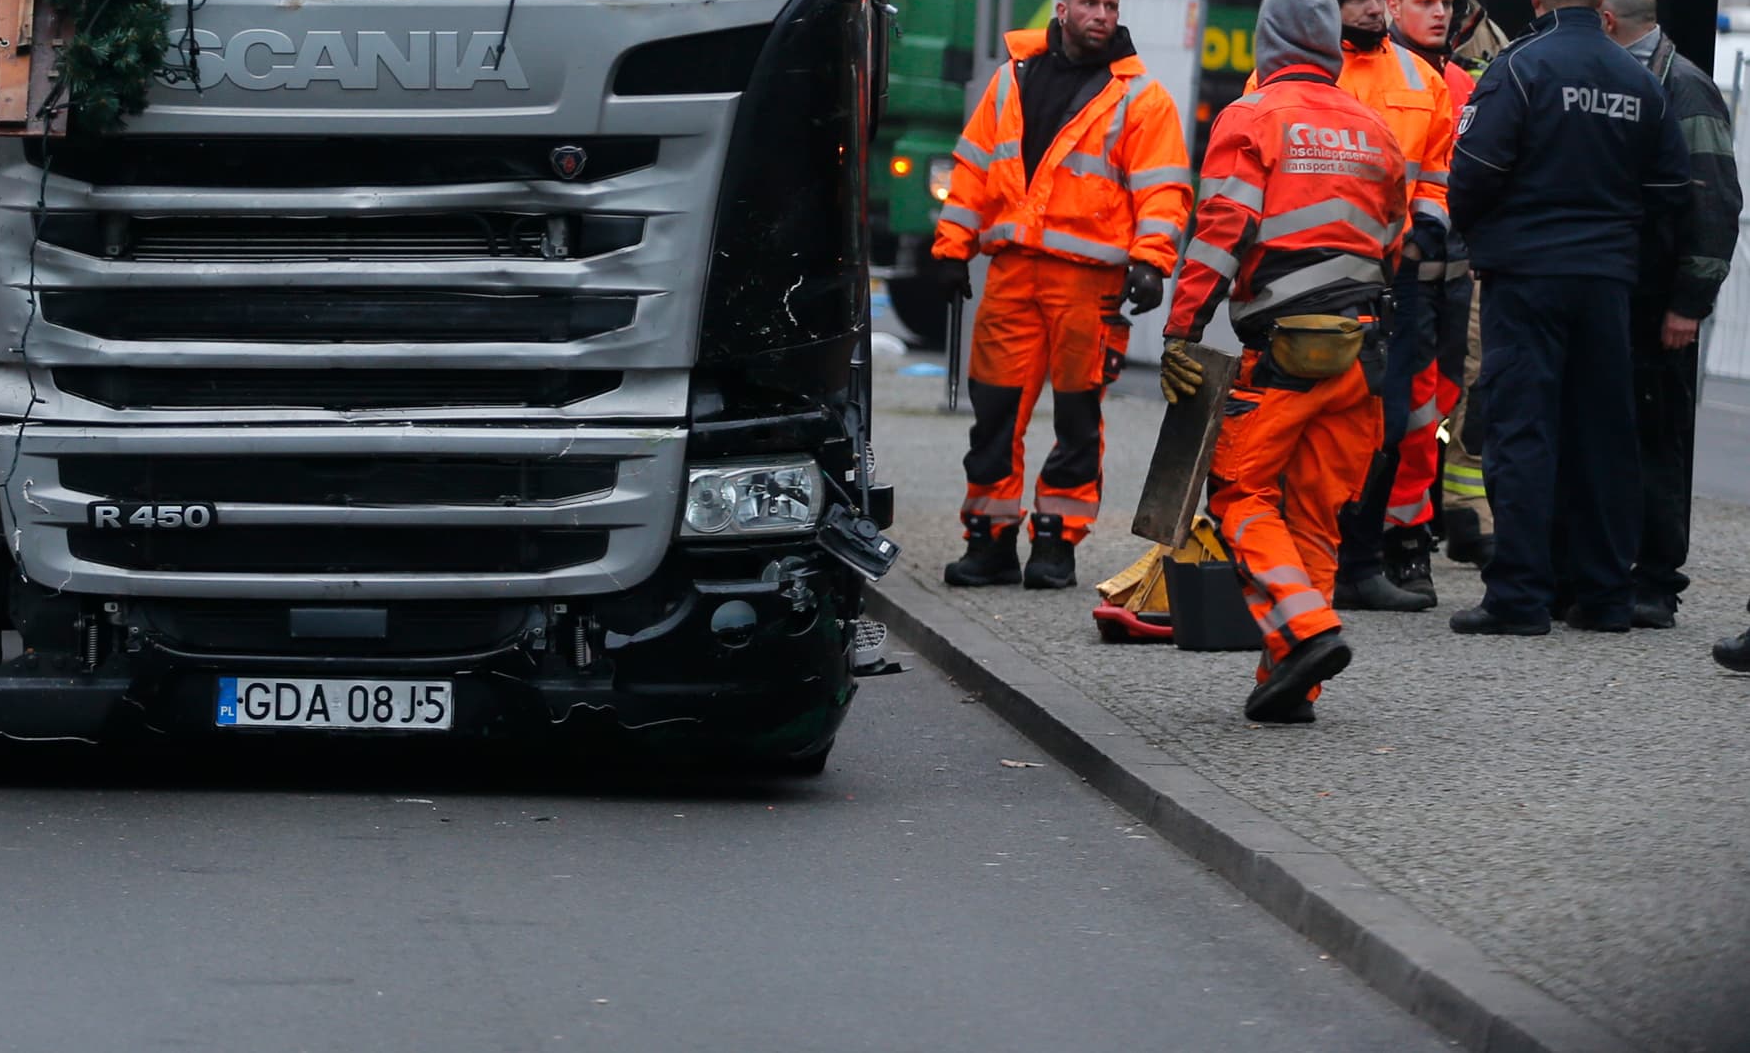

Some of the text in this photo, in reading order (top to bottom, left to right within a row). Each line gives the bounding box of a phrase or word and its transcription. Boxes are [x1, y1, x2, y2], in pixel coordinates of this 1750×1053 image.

[152, 28, 531, 92] SCANIA
[1562, 86, 1641, 123] POLIZEI
[1281, 122, 1383, 154] KROLL
[95, 505, 211, 528] R 450
[220, 706, 235, 717] PL
[244, 682, 445, 724] GDA 08J5
